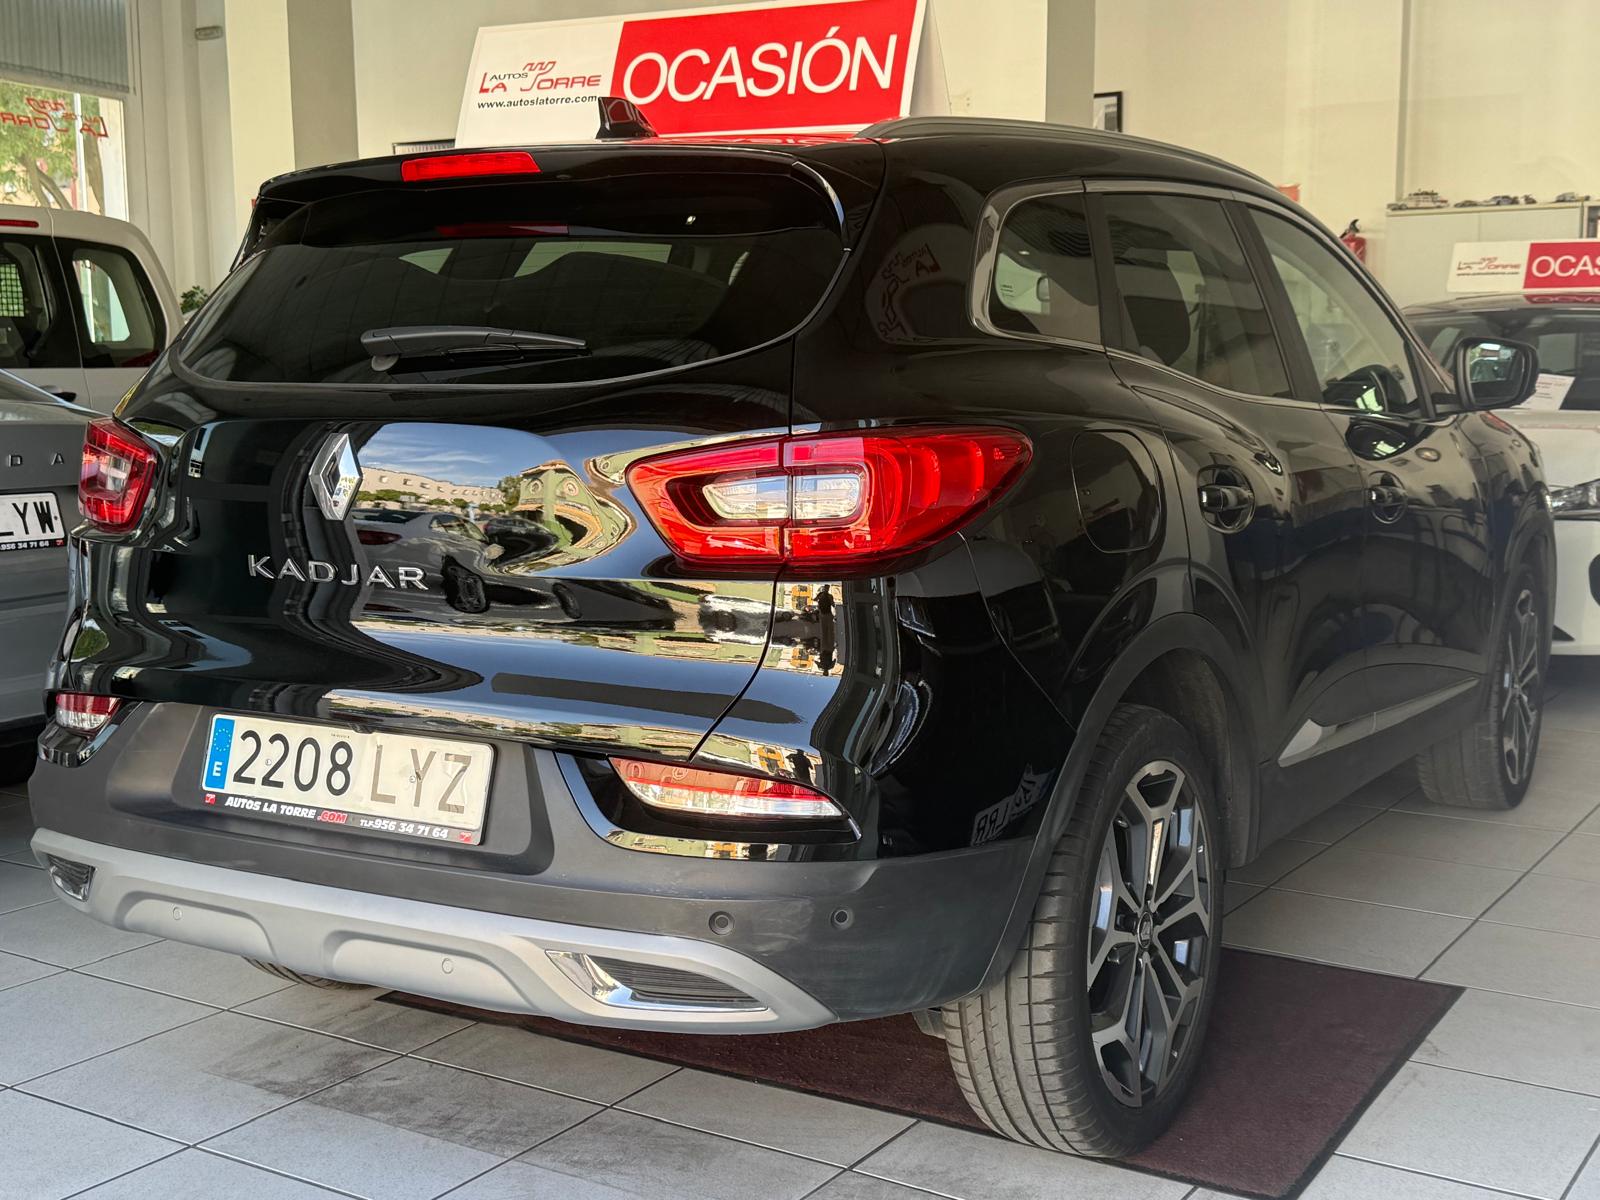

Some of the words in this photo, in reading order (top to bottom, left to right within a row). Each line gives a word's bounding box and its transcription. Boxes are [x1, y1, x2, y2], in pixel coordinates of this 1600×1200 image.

[622, 26, 897, 105] OCASIÓN
[479, 72, 507, 93] LA
[490, 72, 528, 81] AUTOS
[477, 95, 598, 109] www.autoslatorre.com
[247, 555, 429, 591] KADJAR
[212, 761, 222, 777] E
[232, 729, 353, 797] 2208
[370, 744, 472, 814] LYZ
[225, 796, 262, 811] AUTOS
[262, 803, 278, 814] LA
[279, 805, 317, 819] TORRE
[398, 822, 414, 834] 34
[417, 825, 430, 836] 71
[432, 829, 449, 839] 64
